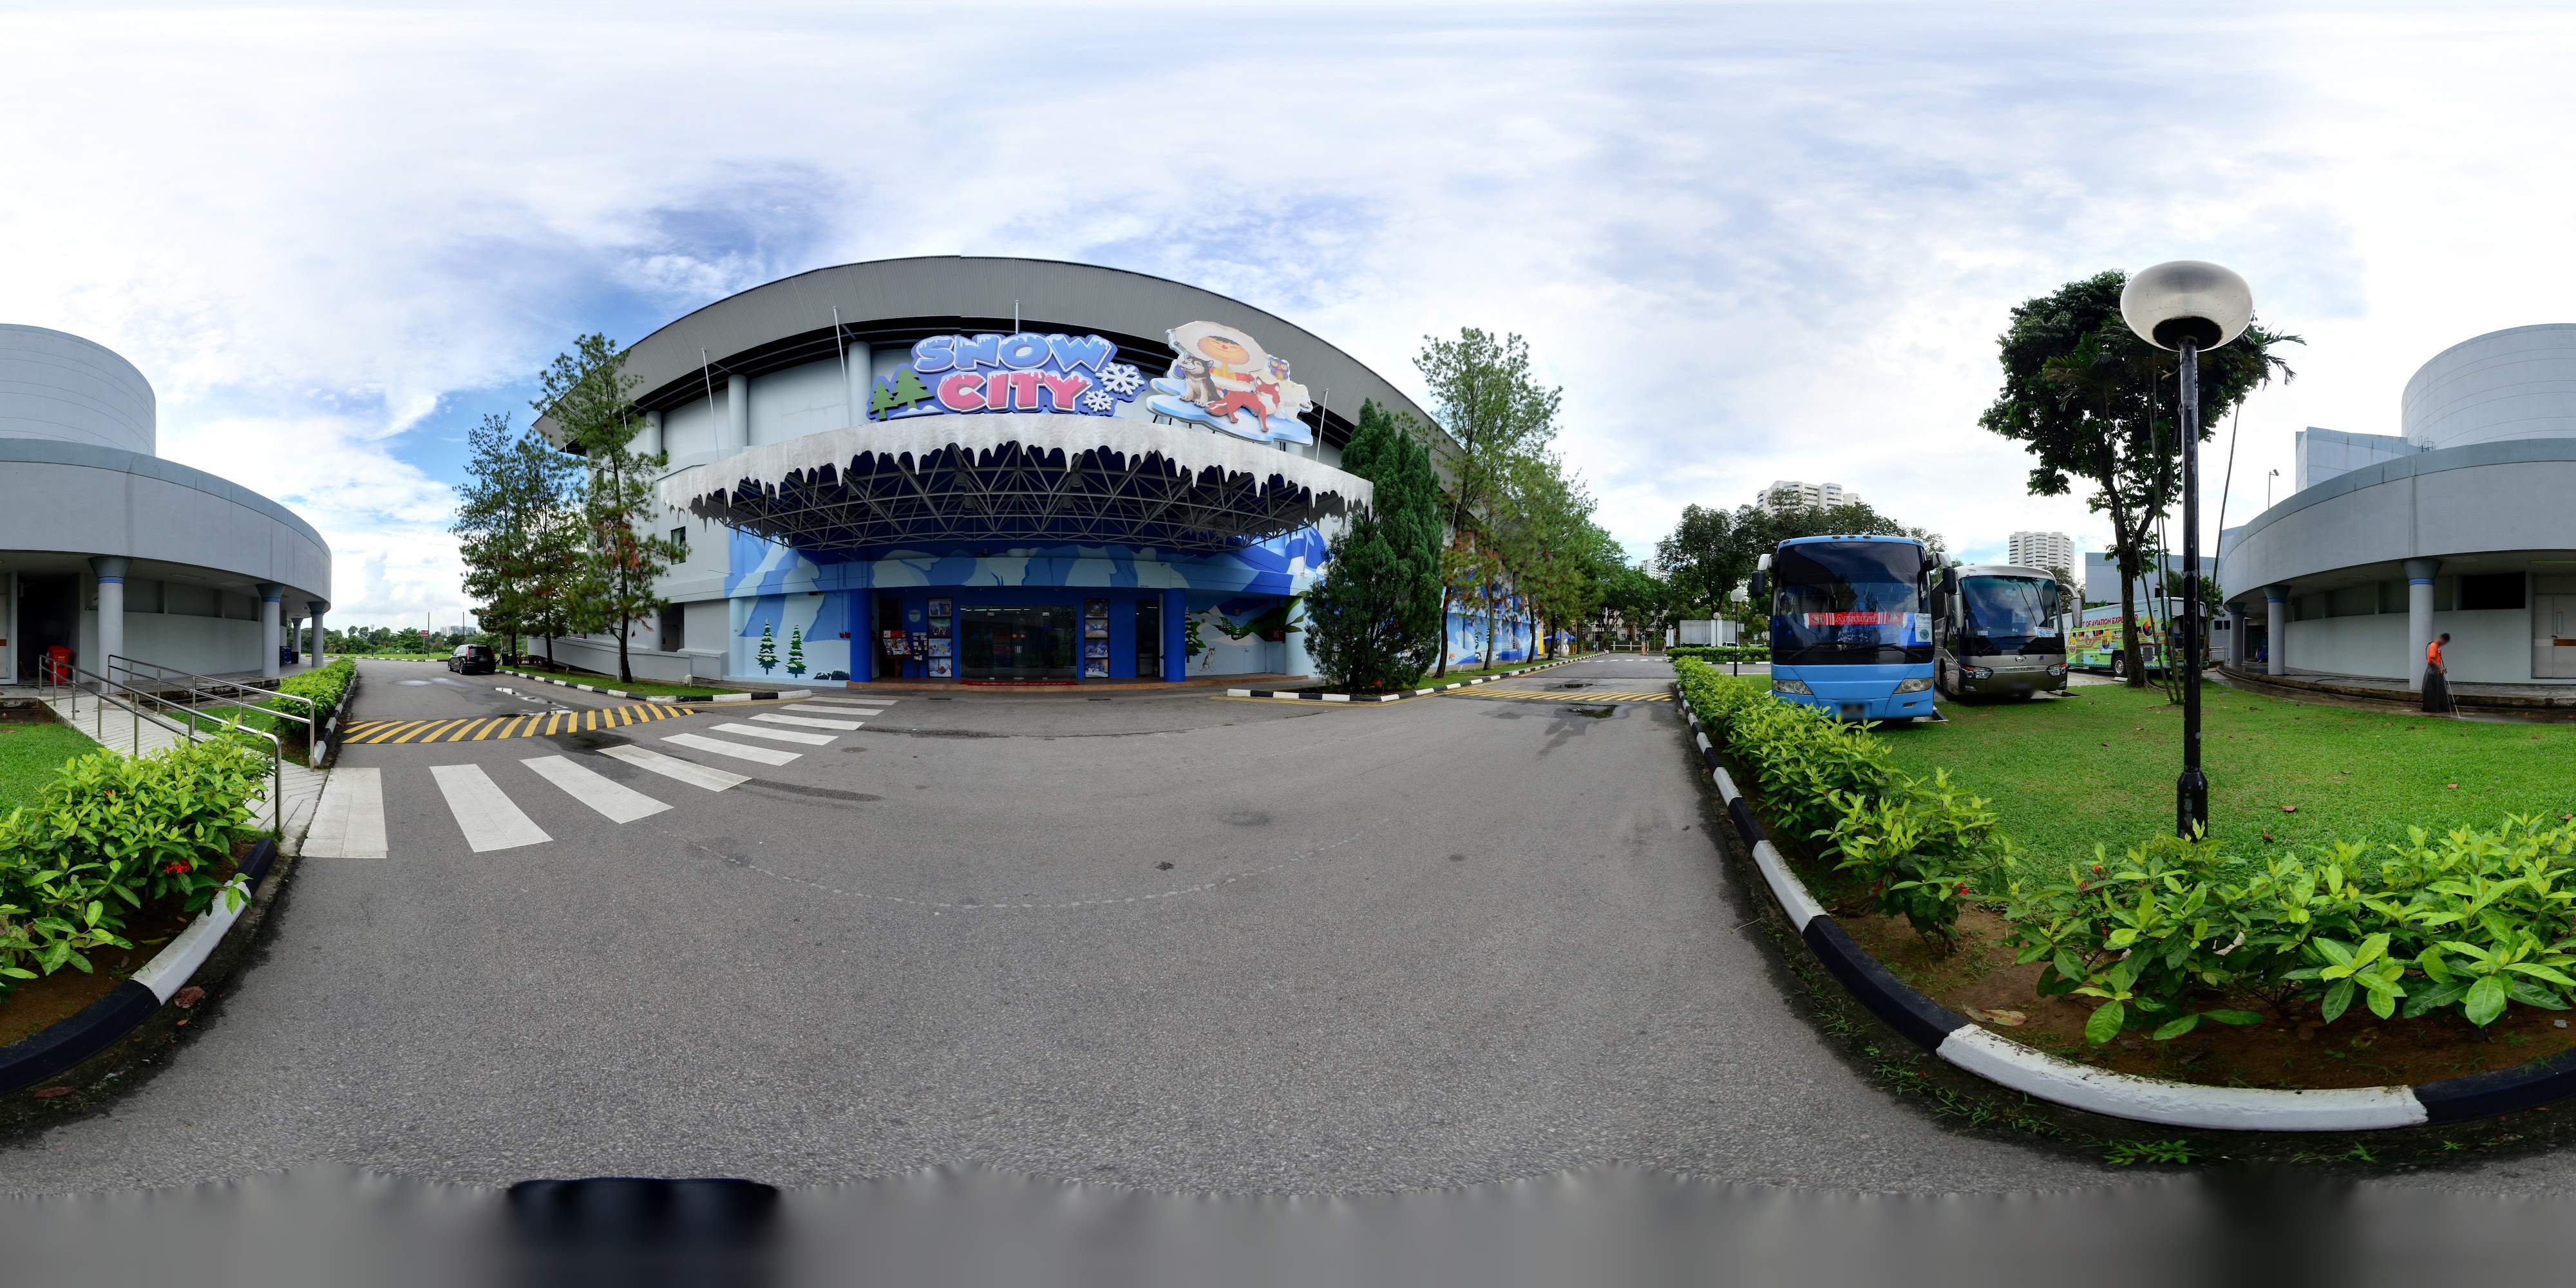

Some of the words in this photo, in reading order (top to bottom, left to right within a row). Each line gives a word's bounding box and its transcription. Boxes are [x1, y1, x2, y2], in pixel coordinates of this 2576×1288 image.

[914, 334, 1112, 373] SNOW
[937, 368, 1094, 412] CITY
[1835, 614, 1878, 623] Arsenal
[2091, 618, 2112, 627] AVIATION
